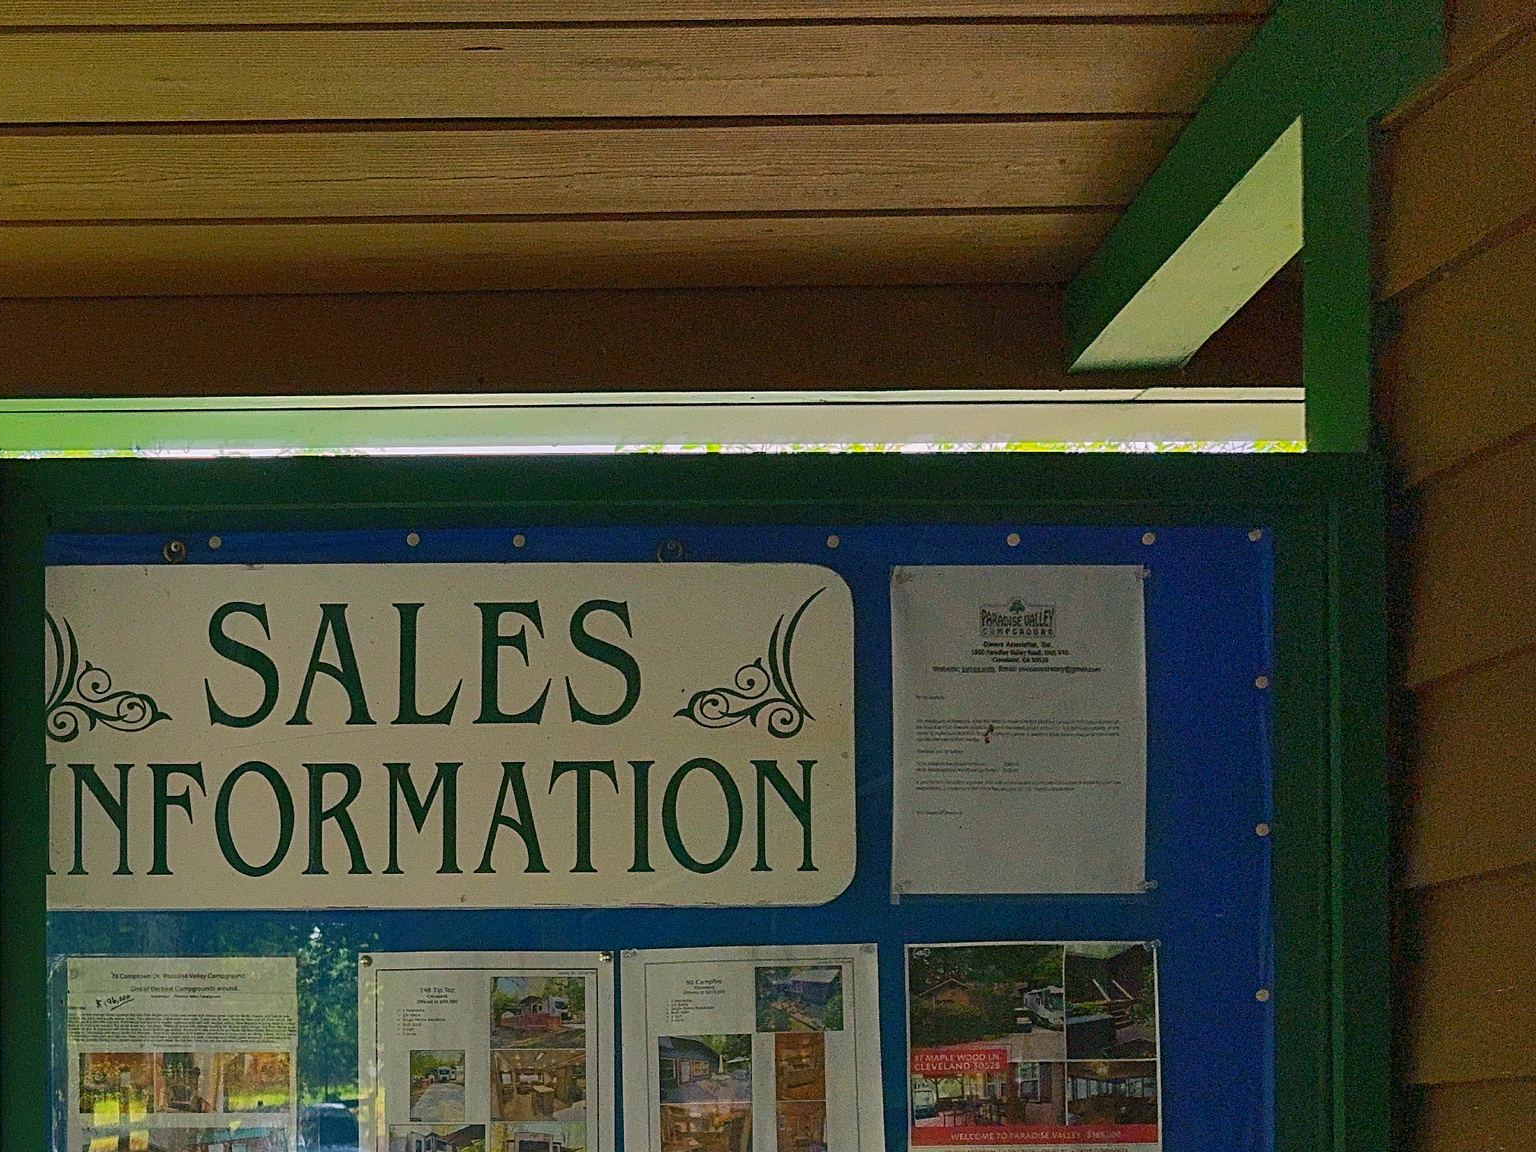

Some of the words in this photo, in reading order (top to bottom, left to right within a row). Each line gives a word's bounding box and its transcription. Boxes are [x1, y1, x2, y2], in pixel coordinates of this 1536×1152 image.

[981, 608, 1022, 628] PARADISE
[1024, 608, 1055, 627] VALLEY
[204, 599, 642, 728] SALES
[914, 1062, 971, 1071] CLEVELAND
